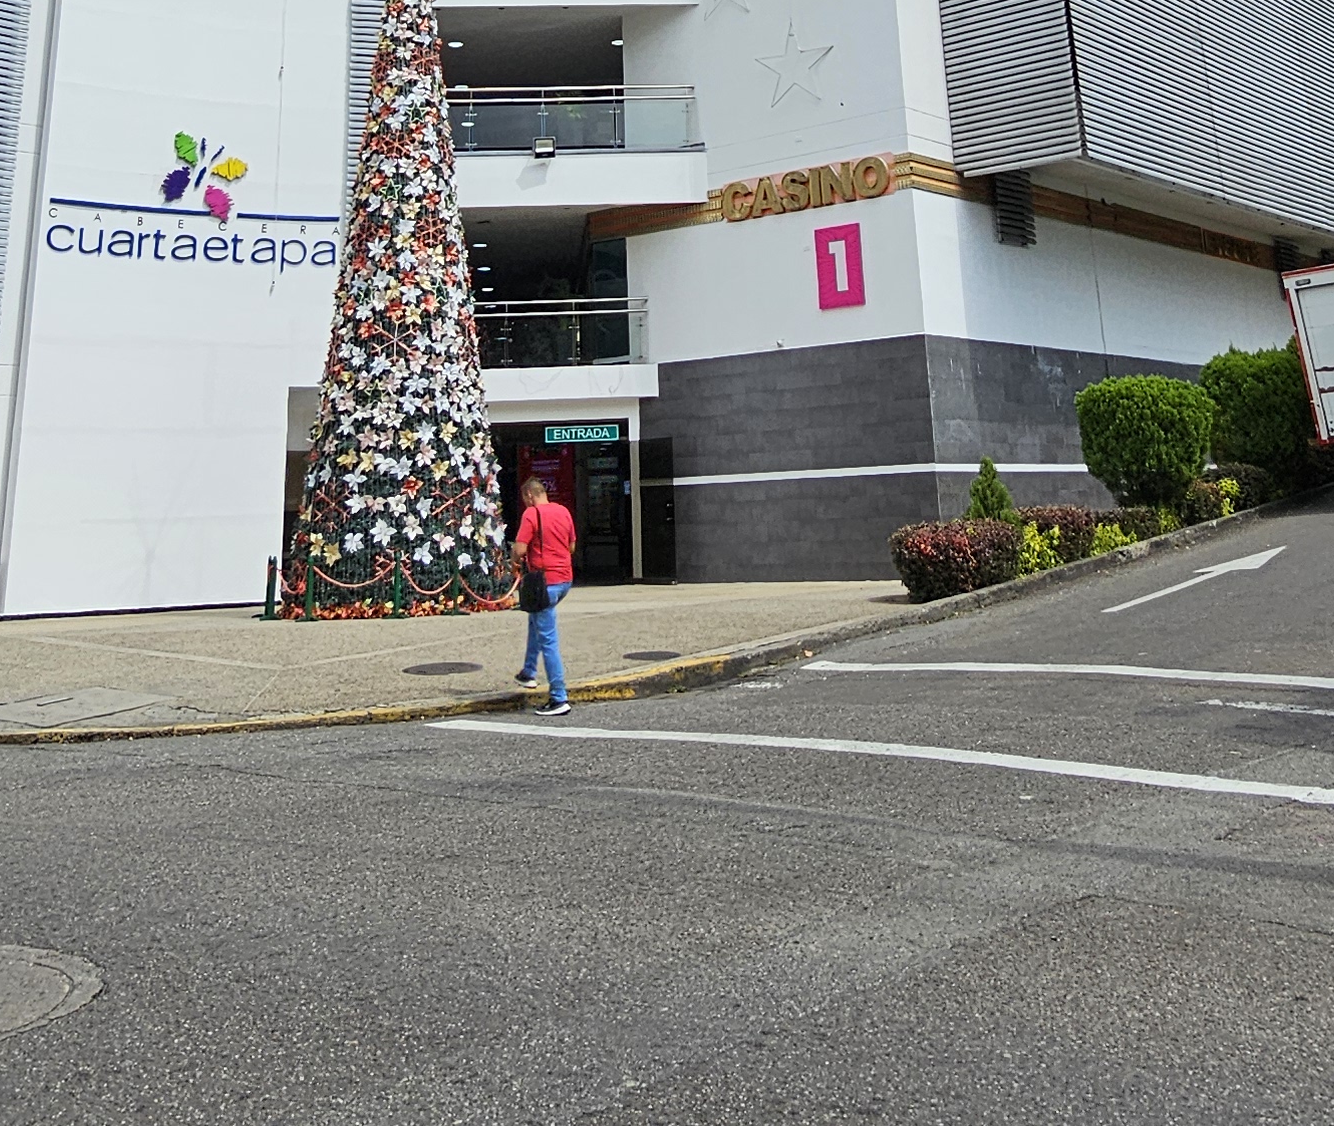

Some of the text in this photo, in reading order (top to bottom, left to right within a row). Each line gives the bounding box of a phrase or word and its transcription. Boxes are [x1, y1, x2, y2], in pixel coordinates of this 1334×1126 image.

[721, 155, 891, 222] CASINO
[46, 224, 338, 274] cuartaetapa
[828, 239, 849, 293] 1
[552, 427, 611, 440] ENTRADA
